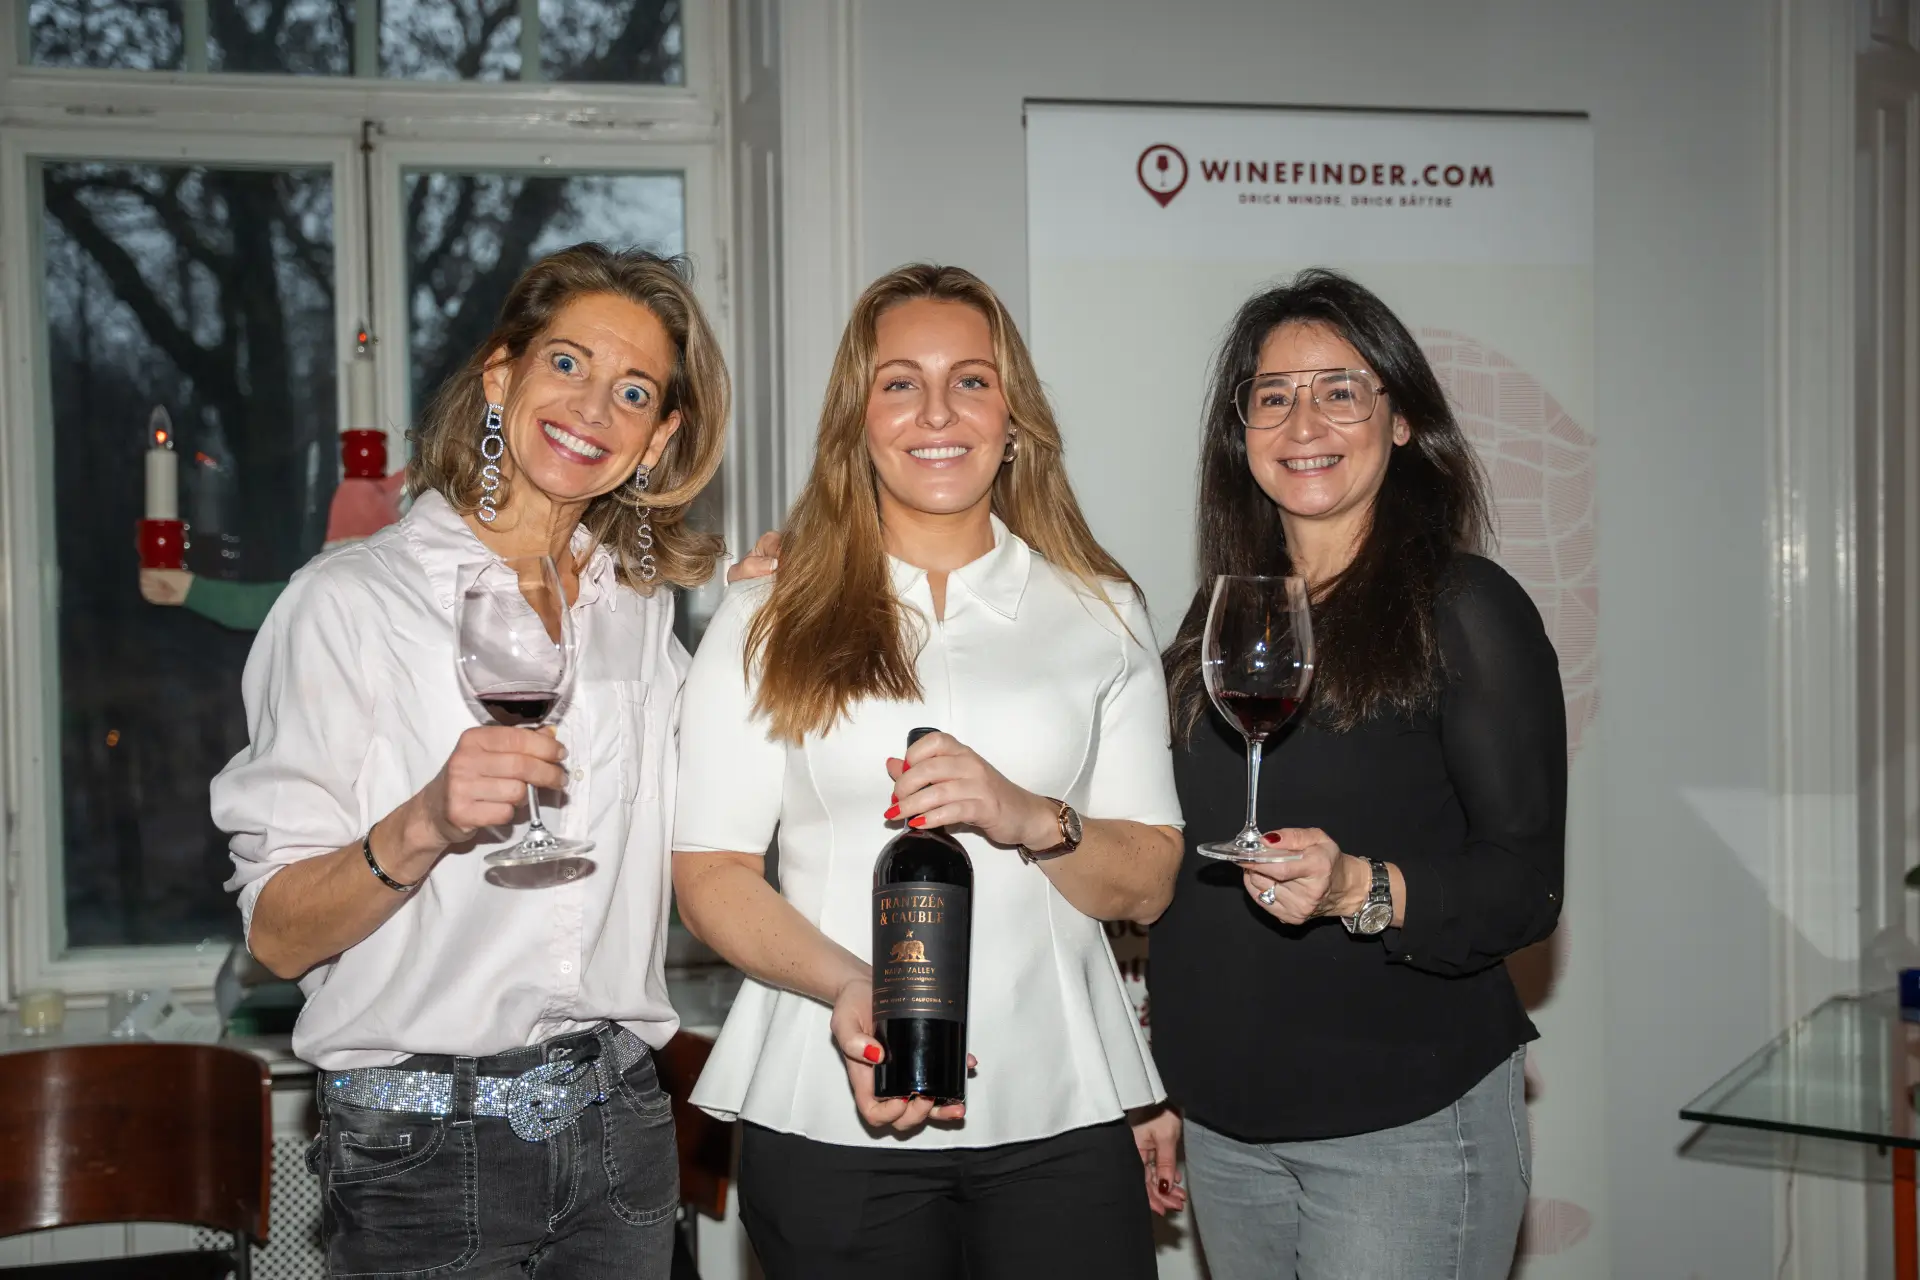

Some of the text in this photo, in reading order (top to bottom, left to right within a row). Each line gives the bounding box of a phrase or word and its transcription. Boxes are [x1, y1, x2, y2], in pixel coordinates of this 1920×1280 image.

[1200, 160, 1495, 188] WINEFINDER.COM
[1239, 193, 1281, 205] DRICK
[1351, 195, 1393, 207] DRICK
[1400, 194, 1453, 208] BÄTTRE
[479, 403, 504, 522] BOSS
[881, 894, 944, 910] FRANTZÉN
[880, 911, 888, 926] &
